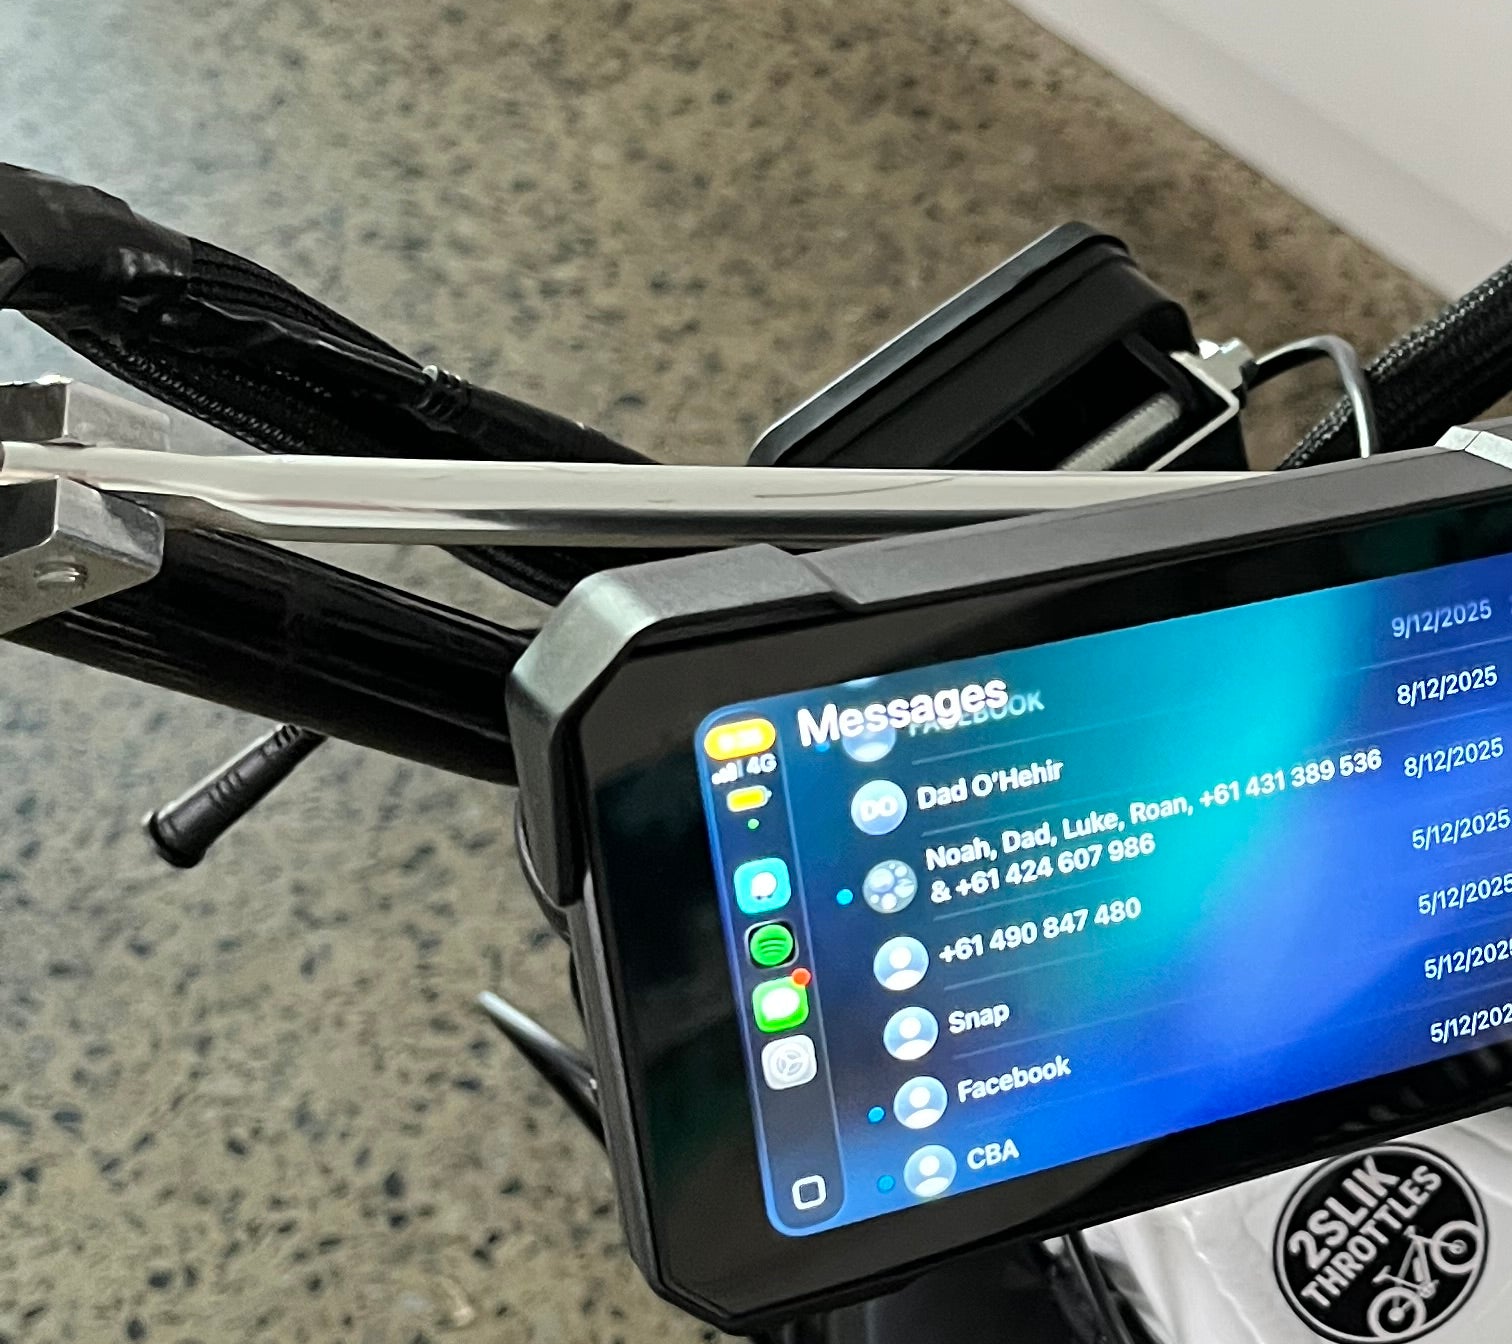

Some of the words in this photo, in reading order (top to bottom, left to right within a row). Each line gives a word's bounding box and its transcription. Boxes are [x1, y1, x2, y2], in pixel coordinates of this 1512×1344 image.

[1391, 598, 1492, 639] 9/12/2025
[1397, 665, 1498, 707] 8/12/2025
[797, 679, 1009, 747] Messages
[746, 753, 777, 774] 4G
[1404, 737, 1504, 779] 8/12/2025
[860, 796, 898, 822] DO
[917, 777, 968, 810] Dad
[925, 836, 997, 871] Noah,
[1001, 821, 1058, 854] Dad,
[1062, 810, 1125, 840] Luke,
[1129, 795, 1194, 825] Roan,
[1199, 780, 1240, 808] +61
[1245, 769, 1286, 798] 431
[1290, 759, 1335, 788] 389
[1339, 748, 1382, 777] 536
[1412, 809, 1511, 851] 5/12/2025
[930, 879, 952, 904] &
[955, 867, 1000, 896] +61
[1005, 856, 1054, 885] 424
[1058, 844, 1103, 873] 607
[1107, 832, 1156, 862] 986
[939, 933, 984, 963] +61
[989, 921, 1037, 951] 490
[1042, 908, 1088, 939] 847
[1094, 896, 1142, 926] 480
[948, 1004, 1010, 1034] Snap
[957, 1055, 1072, 1103] Facebook
[967, 1138, 1020, 1170] CBA
[1287, 1155, 1400, 1270] 2SLIK
[1301, 1165, 1442, 1308] THROTTLES
